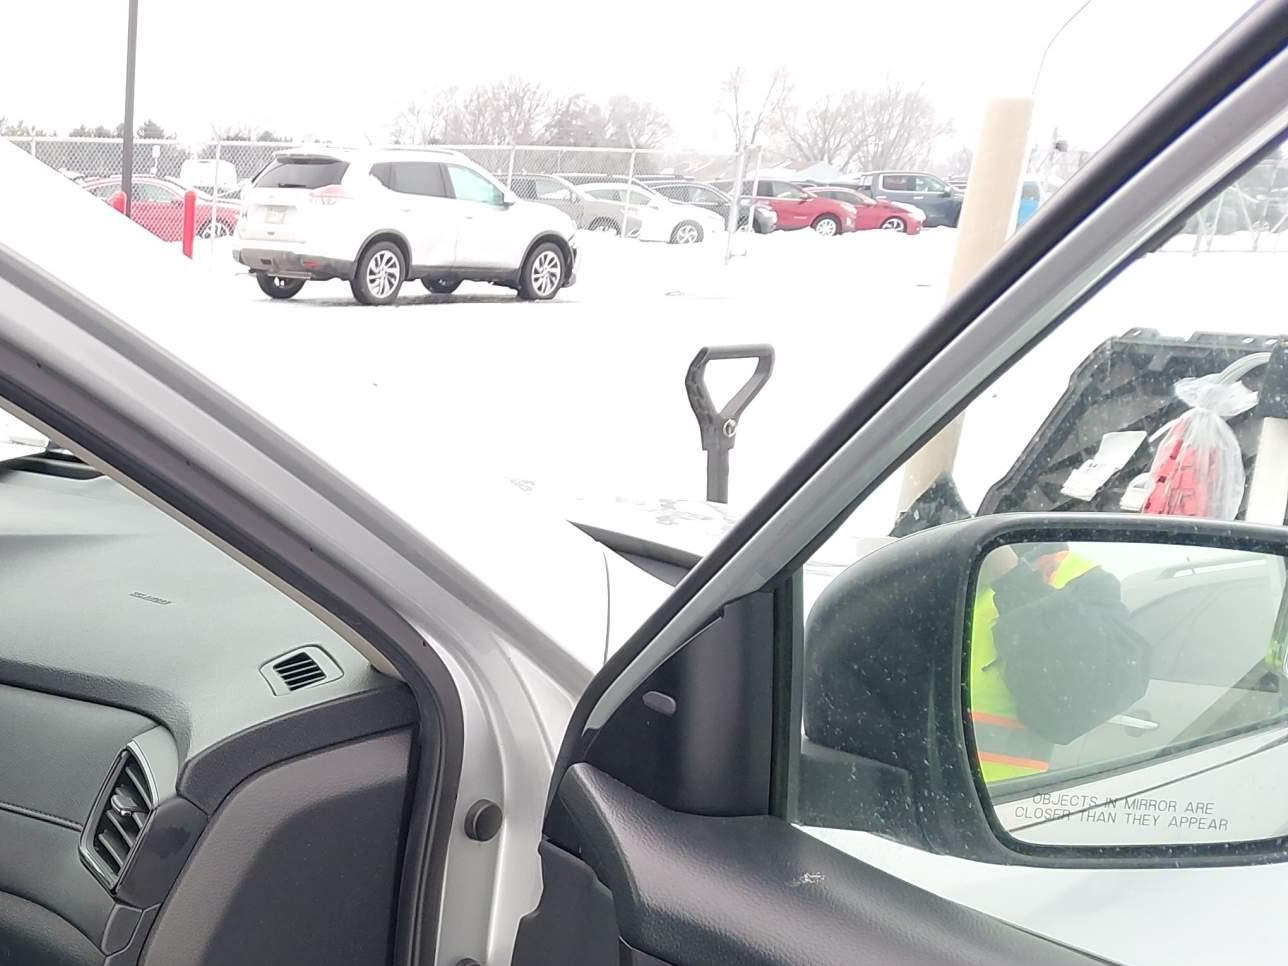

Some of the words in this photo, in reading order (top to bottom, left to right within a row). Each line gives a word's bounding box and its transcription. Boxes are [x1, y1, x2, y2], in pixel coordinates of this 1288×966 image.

[1032, 792, 1098, 808] OBJECTS
[1104, 796, 1117, 810] IN
[1124, 797, 1177, 812] MIRROR
[1184, 801, 1215, 815] ARE
[1014, 806, 1070, 820] CLOSER
[1079, 810, 1117, 824] THAN
[1125, 812, 1160, 826] THEY
[1167, 815, 1229, 832] APPEAR
